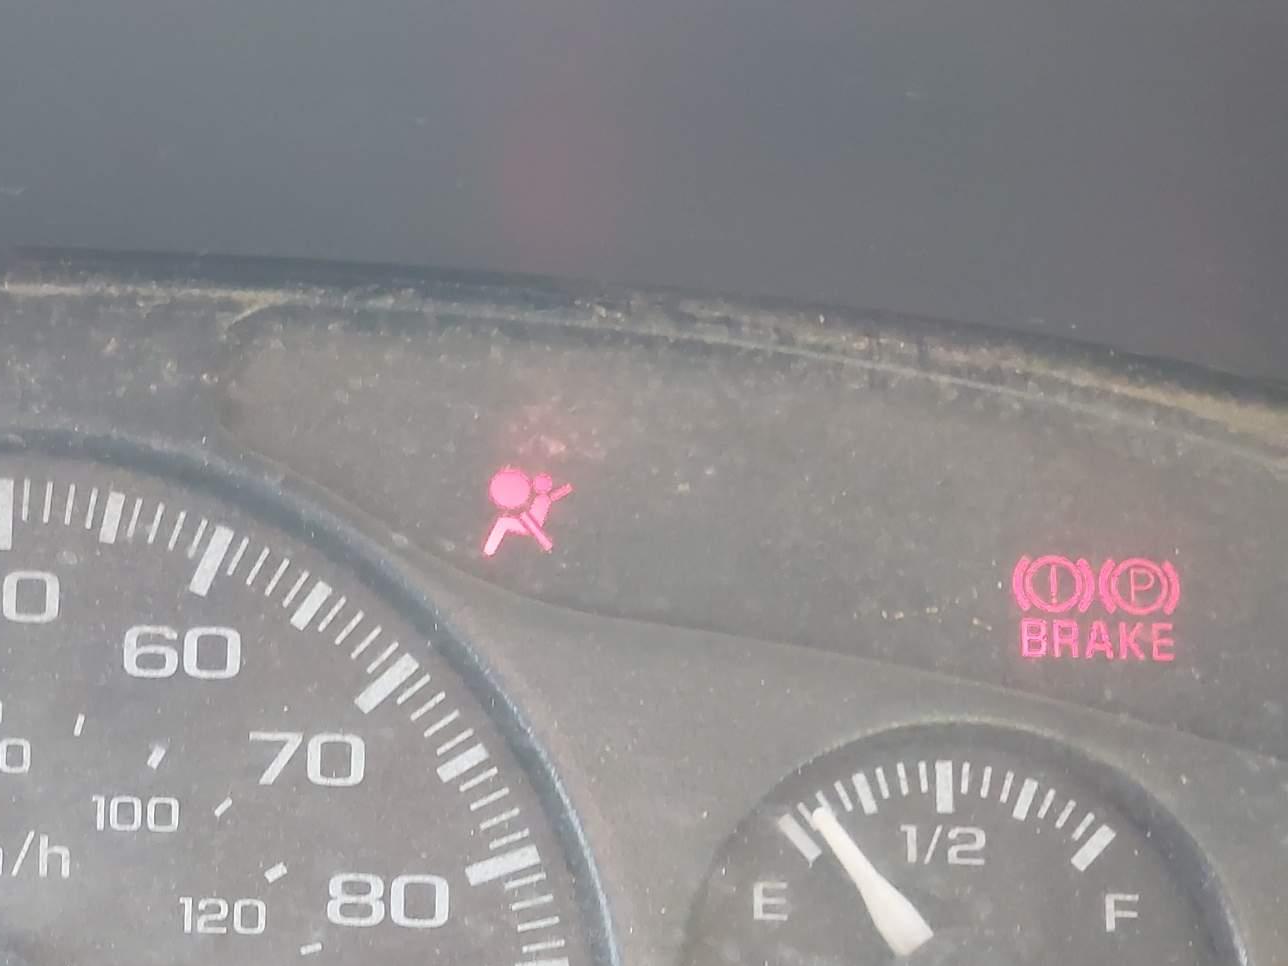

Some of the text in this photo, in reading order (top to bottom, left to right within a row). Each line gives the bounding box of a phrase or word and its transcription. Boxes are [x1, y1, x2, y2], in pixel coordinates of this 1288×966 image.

[1129, 567, 1155, 601] P
[123, 625, 242, 680] 60
[1021, 617, 1175, 662] BRAKE
[248, 731, 366, 786] 70
[92, 795, 180, 832] 100
[899, 823, 987, 867] 1/2
[179, 896, 267, 935] 120
[326, 872, 450, 929] 80
[752, 881, 789, 921] E
[1104, 893, 1140, 932] F
